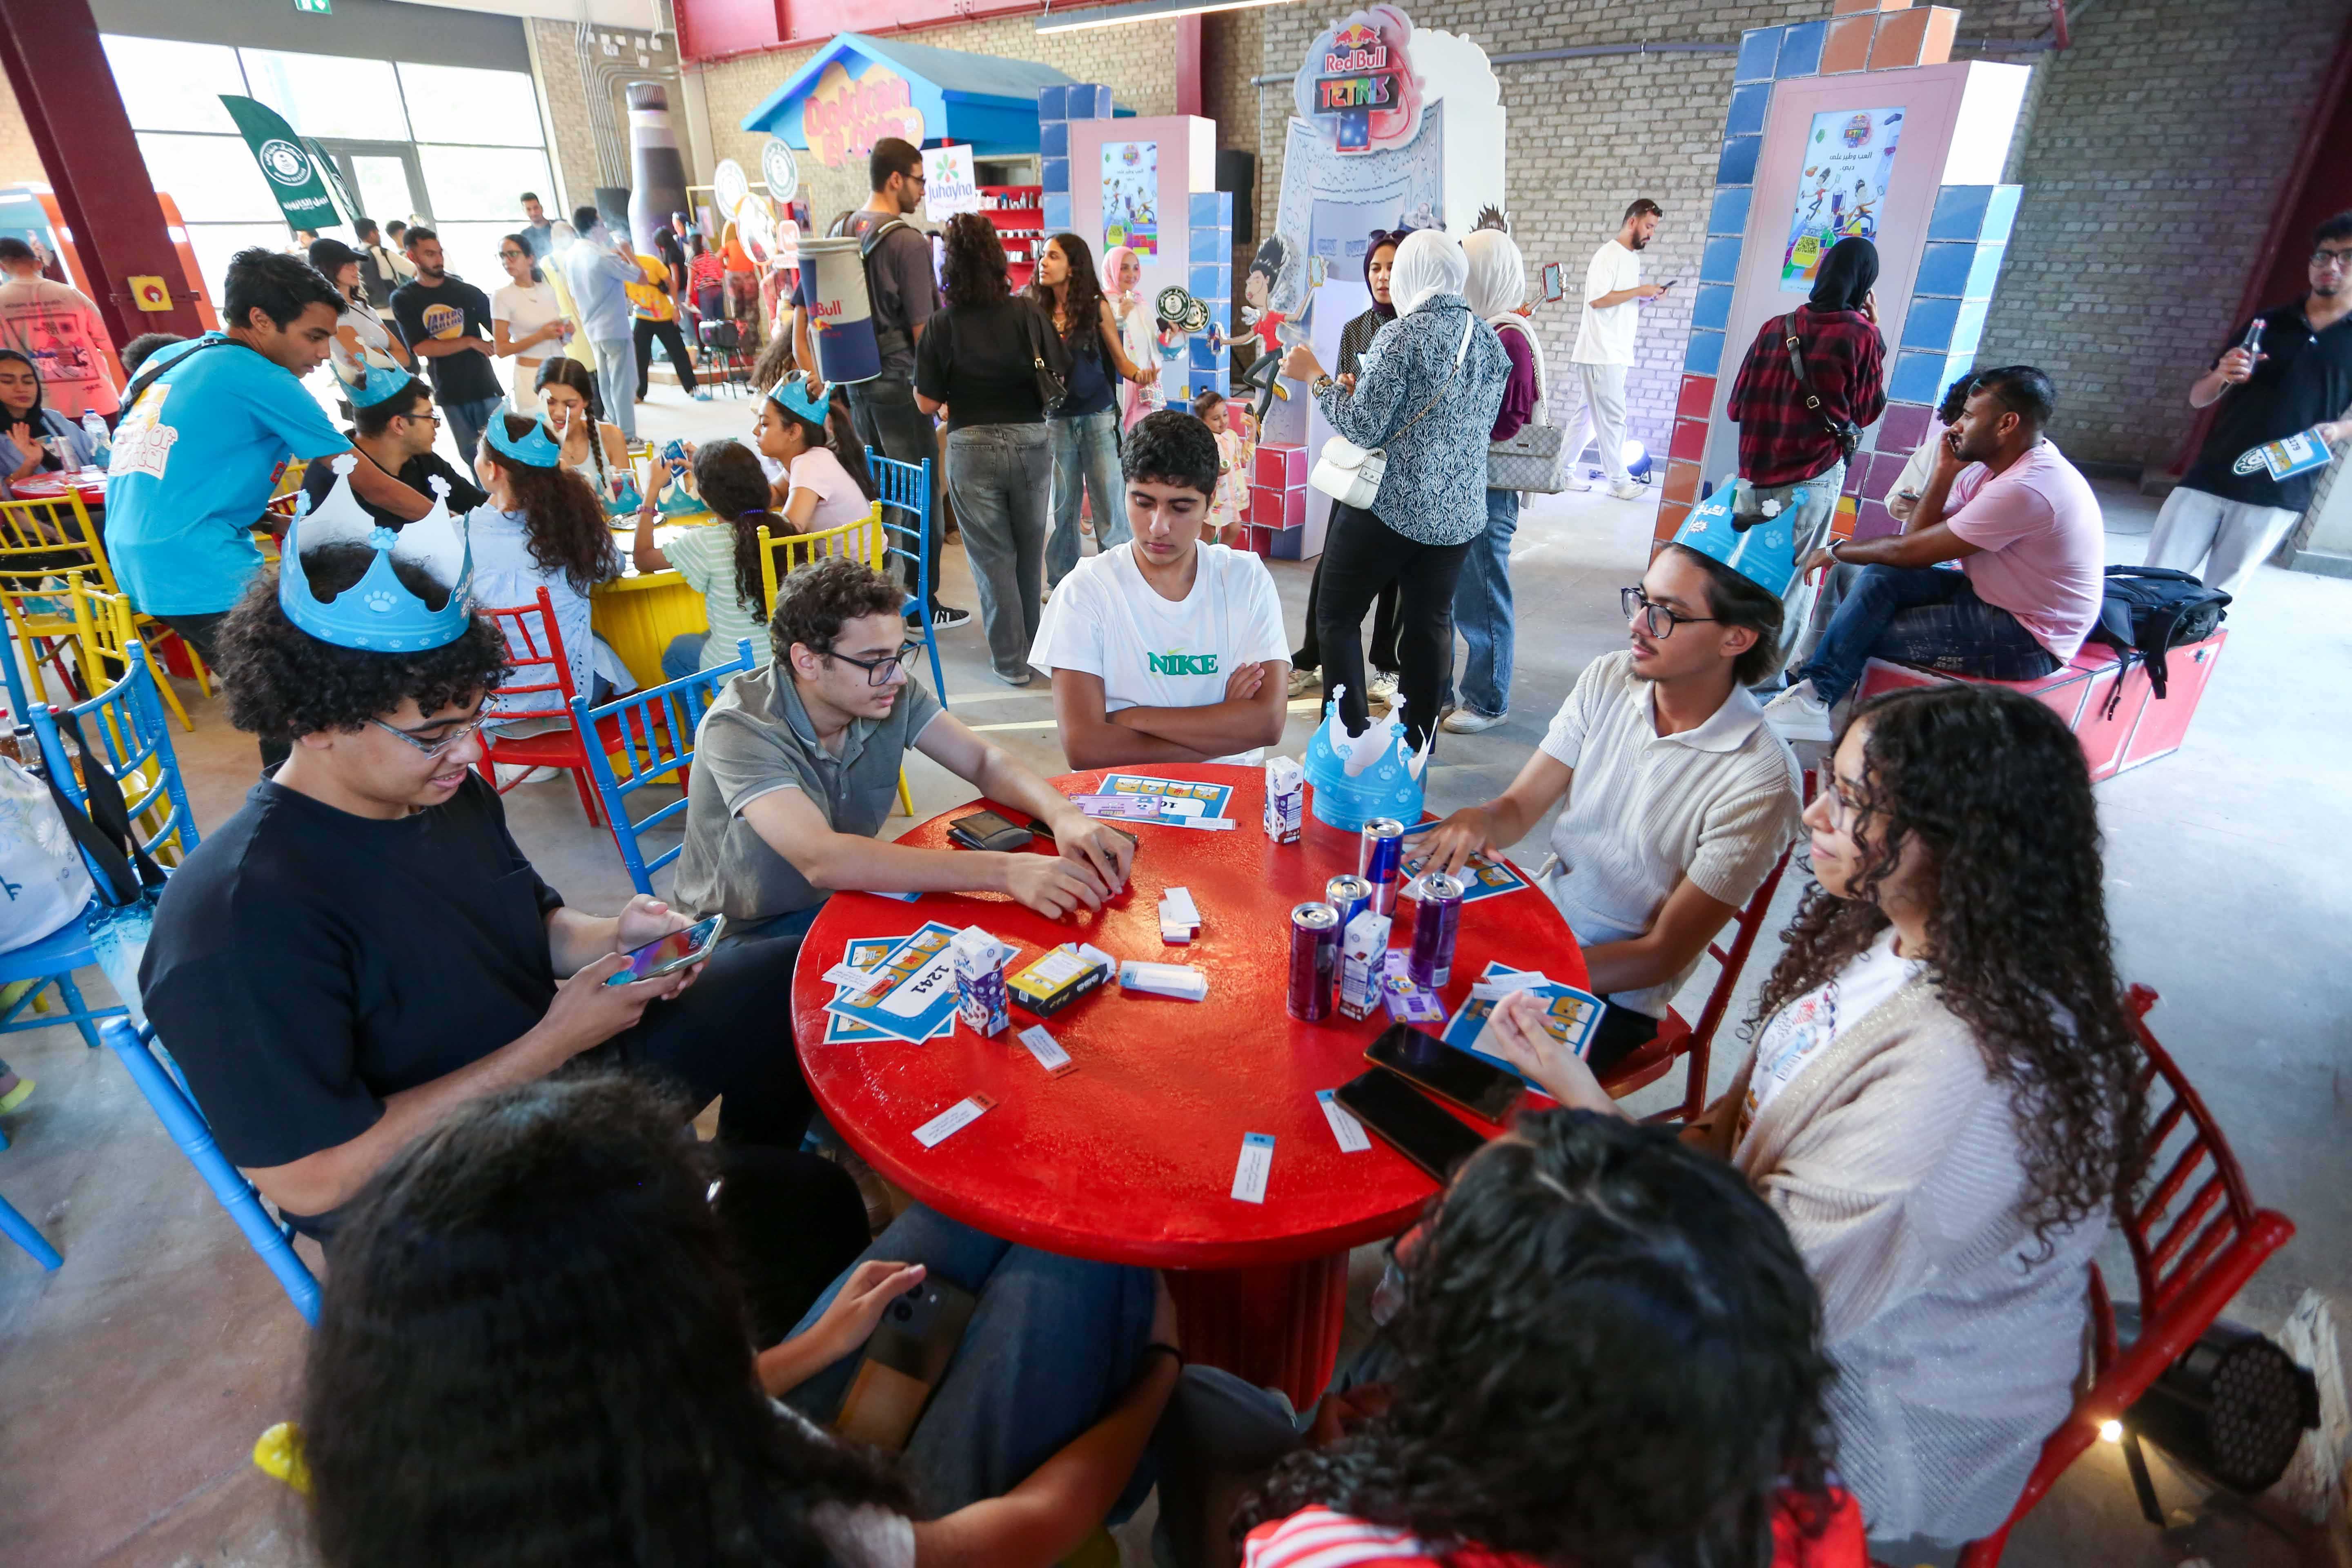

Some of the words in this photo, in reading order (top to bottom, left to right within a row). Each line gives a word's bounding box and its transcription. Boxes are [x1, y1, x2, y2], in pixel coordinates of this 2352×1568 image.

[1326, 49, 1354, 73] Red
[1355, 46, 1387, 71] Bull
[1320, 76, 1389, 108] TETRIS
[804, 78, 910, 137] Dokkan
[1842, 152, 1857, 161] وطير
[1858, 151, 1873, 159] العب
[928, 181, 973, 203] Juhayna
[816, 300, 842, 316] Bull
[1147, 652, 1218, 675] NIKE
[911, 965, 949, 993] 1241
